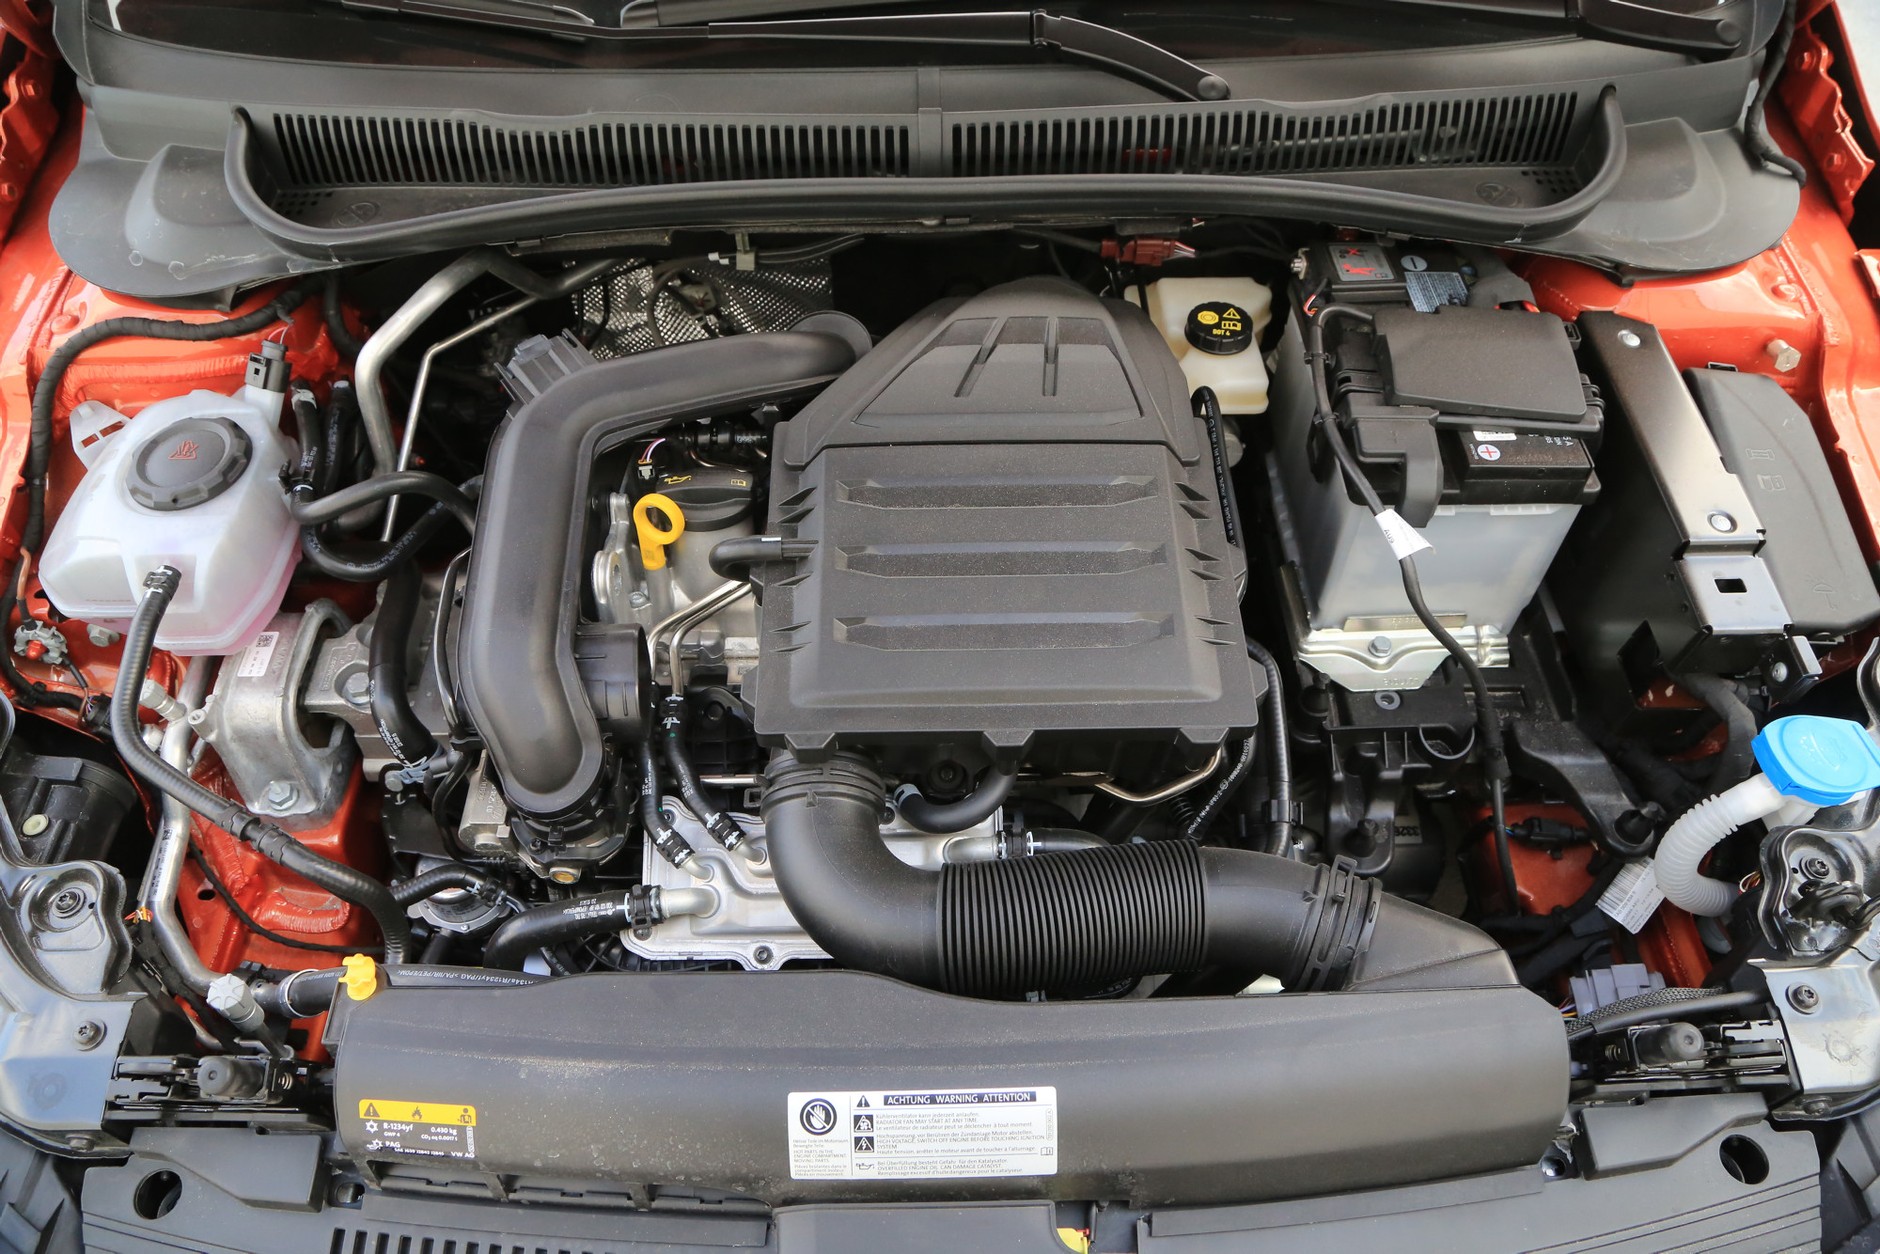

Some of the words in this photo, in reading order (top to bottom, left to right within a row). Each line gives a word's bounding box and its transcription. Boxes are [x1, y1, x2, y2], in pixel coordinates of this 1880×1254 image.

[887, 1095, 930, 1104] ACHTUNG
[936, 1094, 978, 1104] WARNING
[983, 1092, 1030, 1102] ATTENTION
[383, 1123, 413, 1132] R-1234yf
